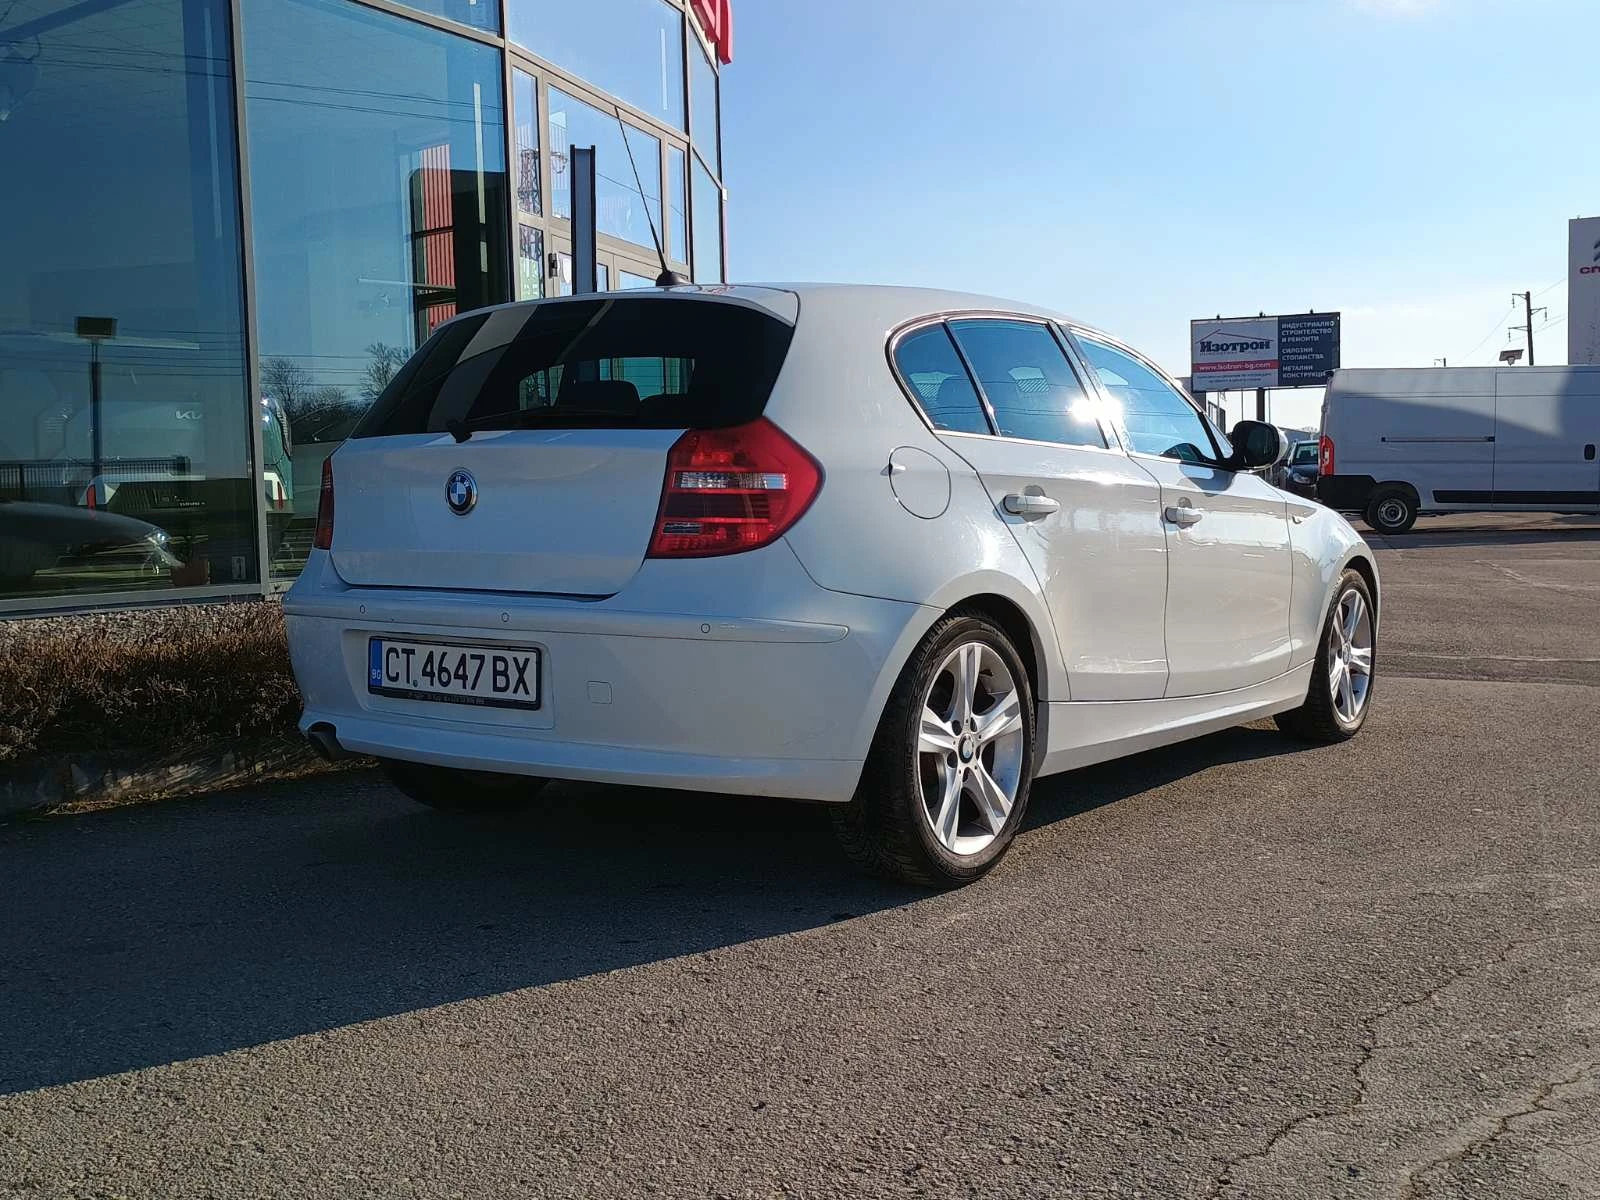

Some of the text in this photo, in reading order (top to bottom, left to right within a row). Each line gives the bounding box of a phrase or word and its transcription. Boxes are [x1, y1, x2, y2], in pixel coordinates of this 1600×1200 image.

[1199, 340, 1271, 353] Изотрон
[421, 650, 486, 691] 4647
[492, 655, 530, 695] BX
